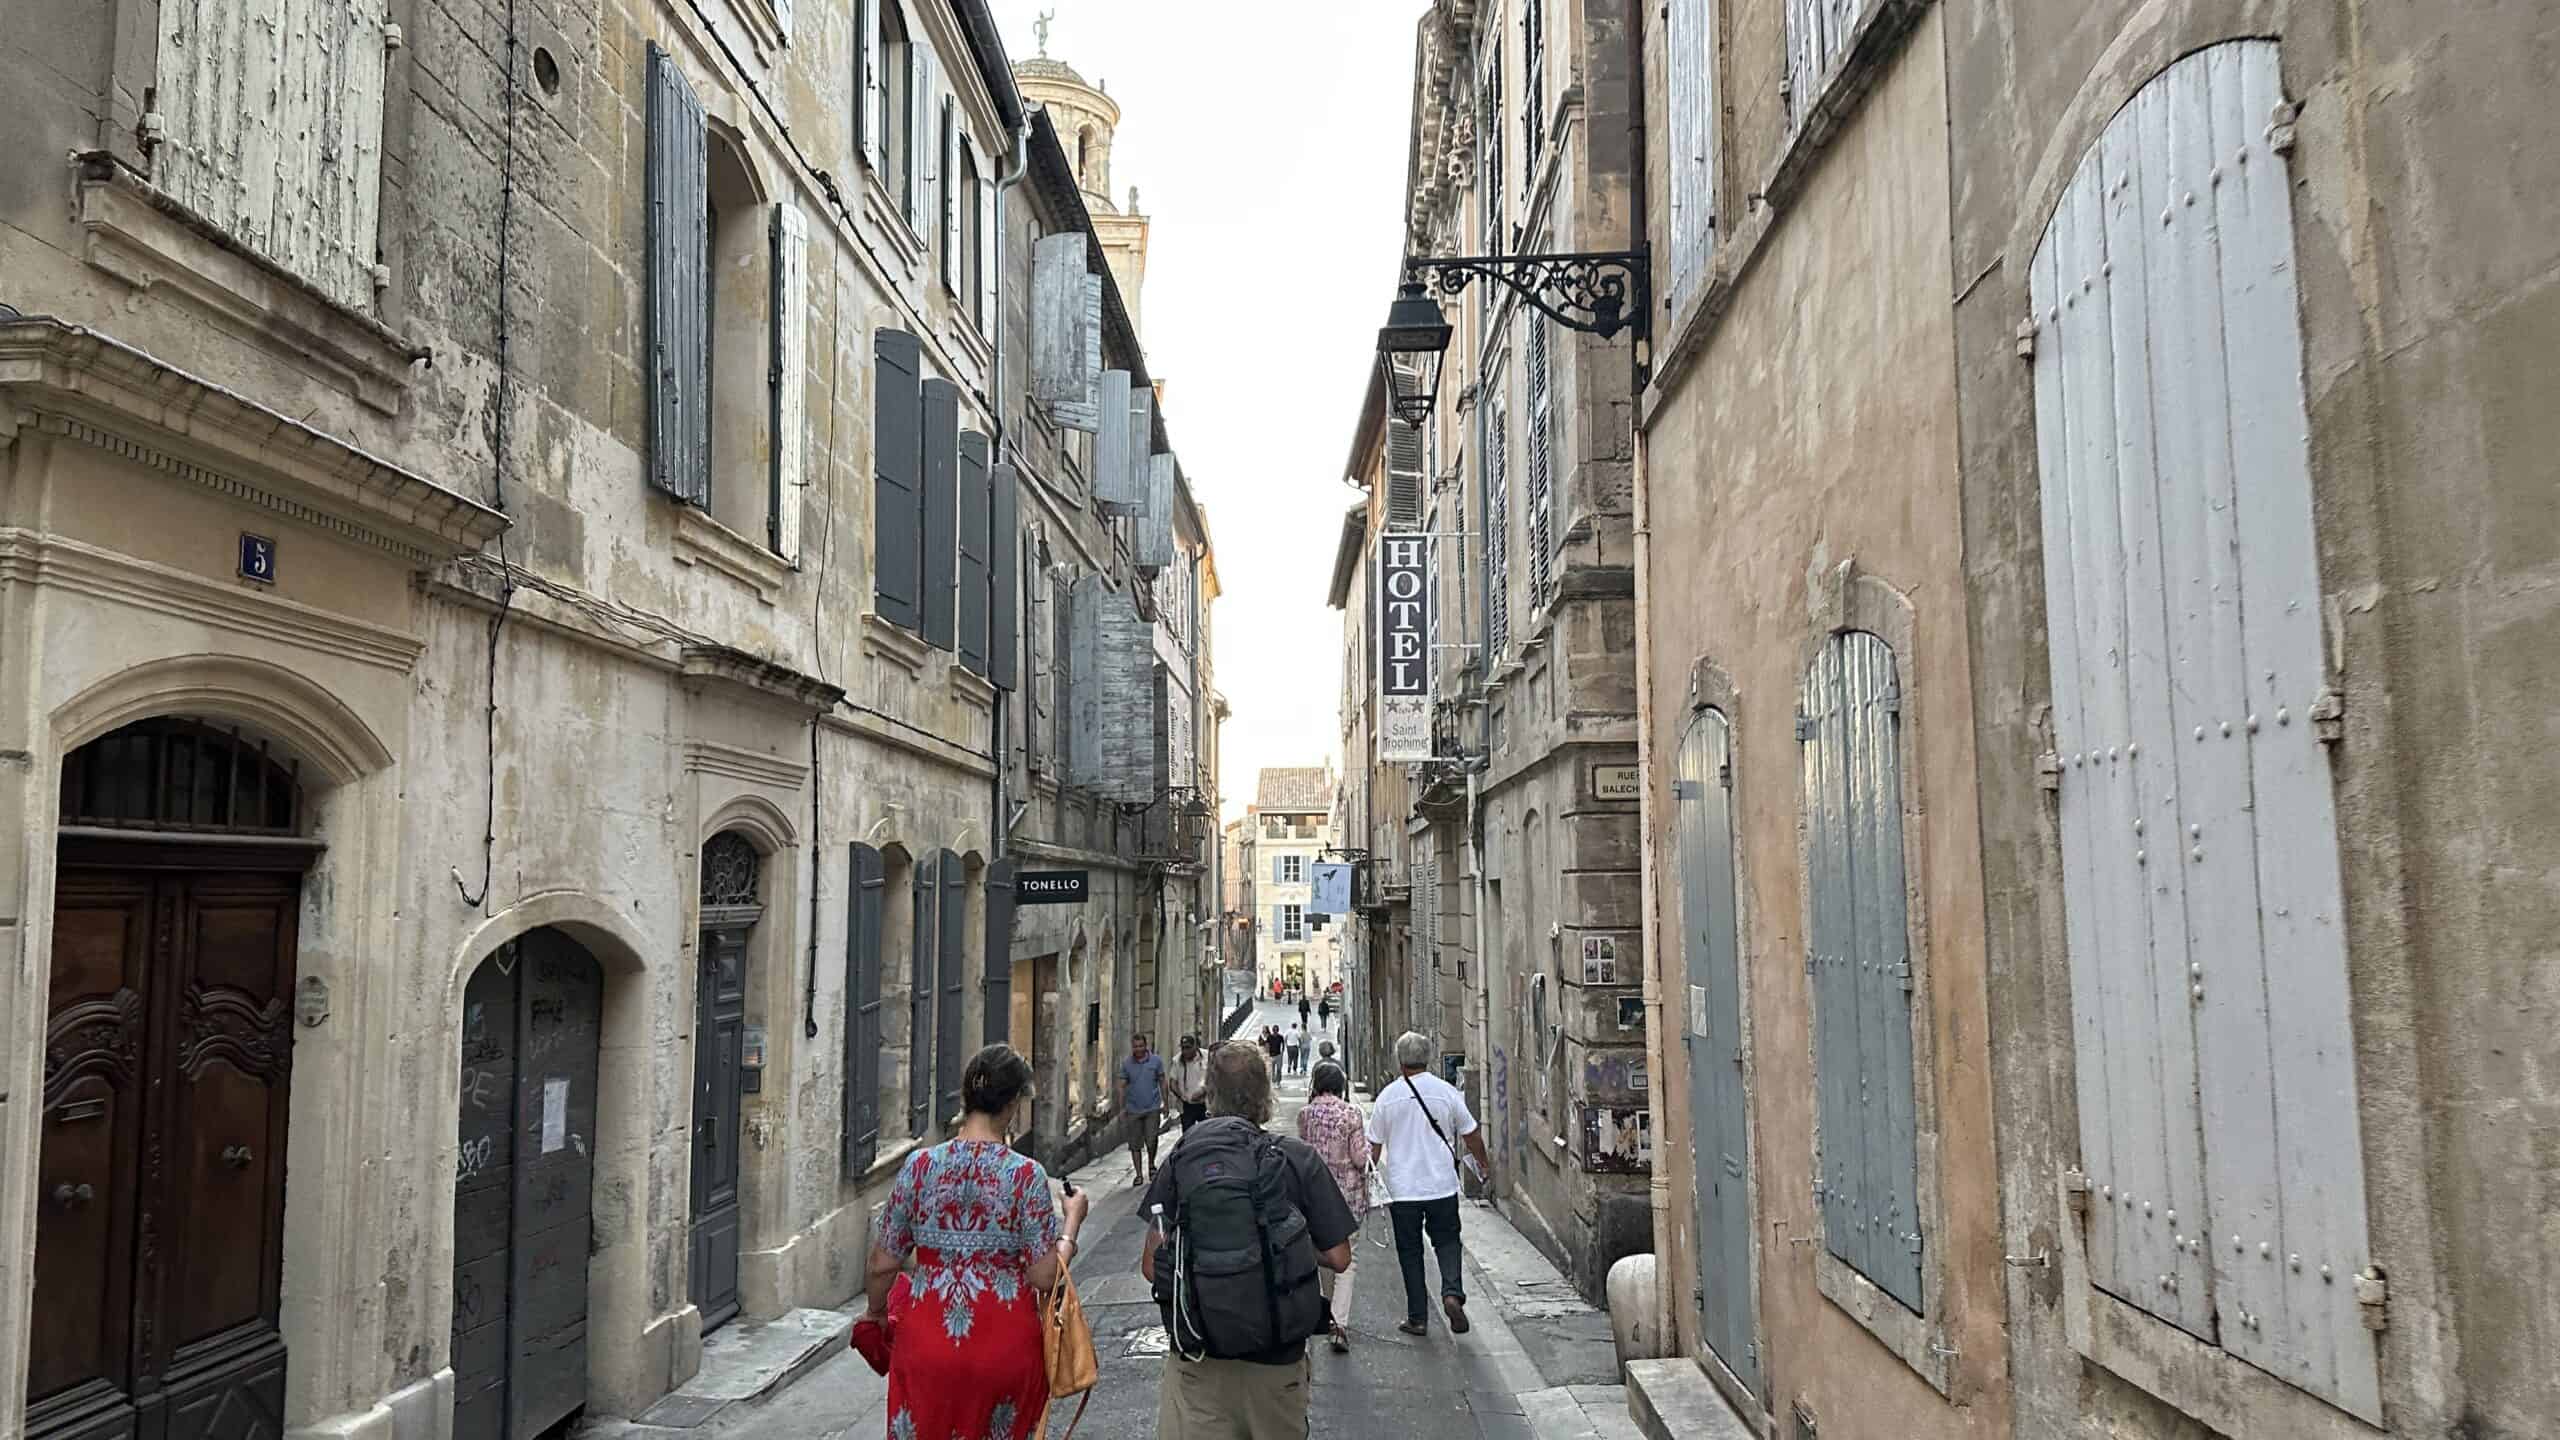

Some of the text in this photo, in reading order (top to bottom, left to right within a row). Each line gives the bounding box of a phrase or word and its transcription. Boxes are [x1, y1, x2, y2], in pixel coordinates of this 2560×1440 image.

[255, 543, 266, 574] 5
[1387, 540, 1422, 690] HOTEL
[1392, 723, 1417, 736] Saint
[1383, 736, 1428, 752] Trophime
[1617, 771, 1635, 780] RUE
[1602, 784, 1640, 793] BALECH
[1022, 879, 1080, 891] TONELLO
